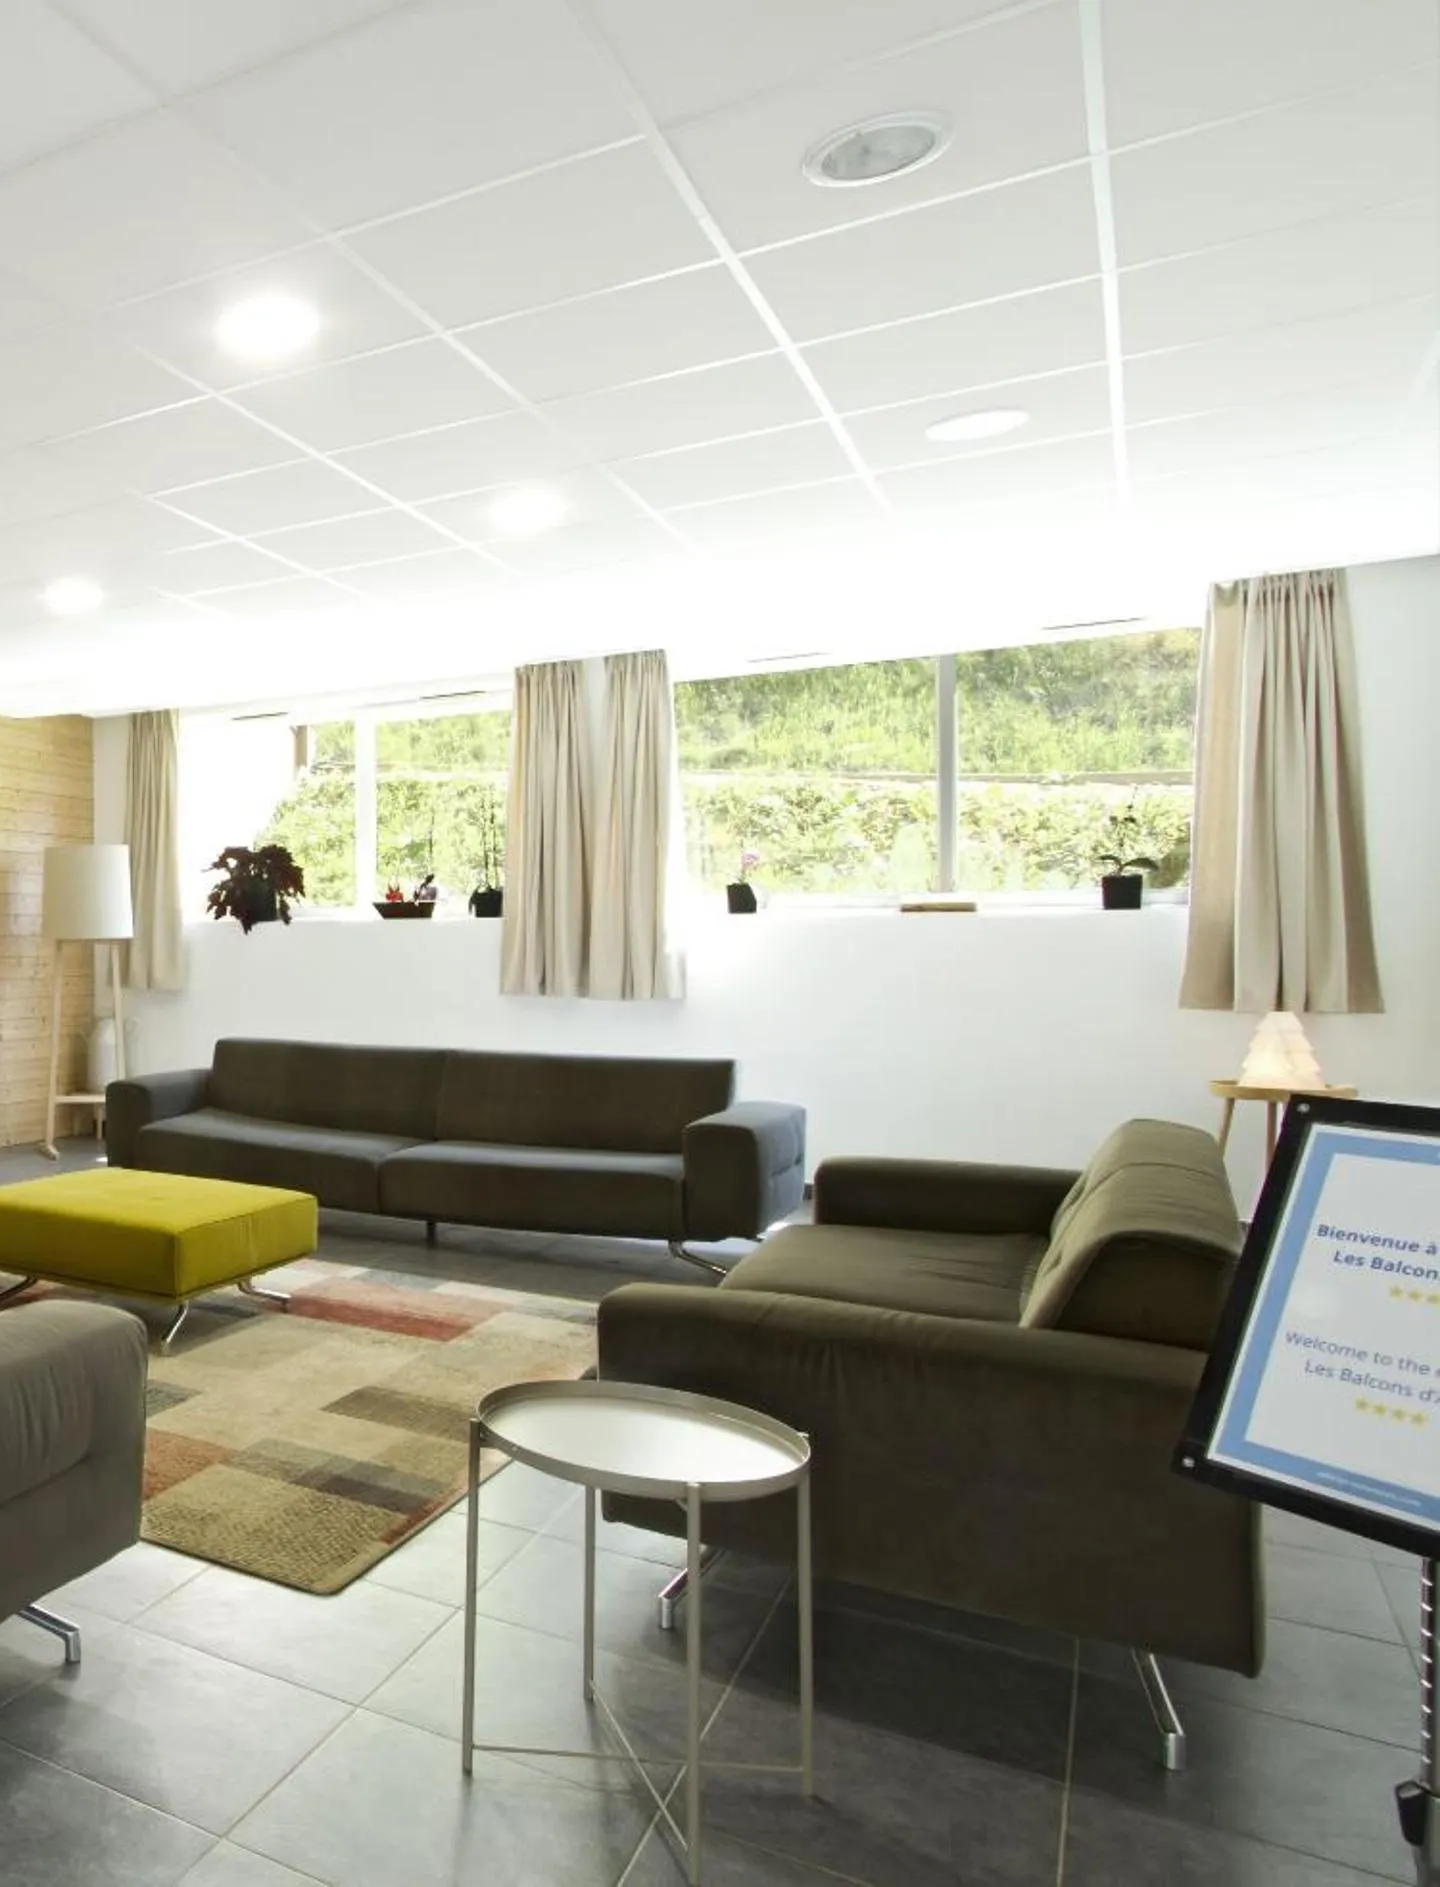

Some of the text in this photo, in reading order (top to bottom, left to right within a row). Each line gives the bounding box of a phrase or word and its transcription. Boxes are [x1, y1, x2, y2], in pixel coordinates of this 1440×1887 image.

[1317, 1224, 1420, 1252] Bienvenue
[1333, 1249, 1440, 1280] Les Balcon
[1285, 1330, 1368, 1362] Welcome
[1373, 1351, 1393, 1366] to
[1397, 1356, 1430, 1375] the
[1304, 1359, 1335, 1378] Les
[1339, 1367, 1413, 1397] Balcons
